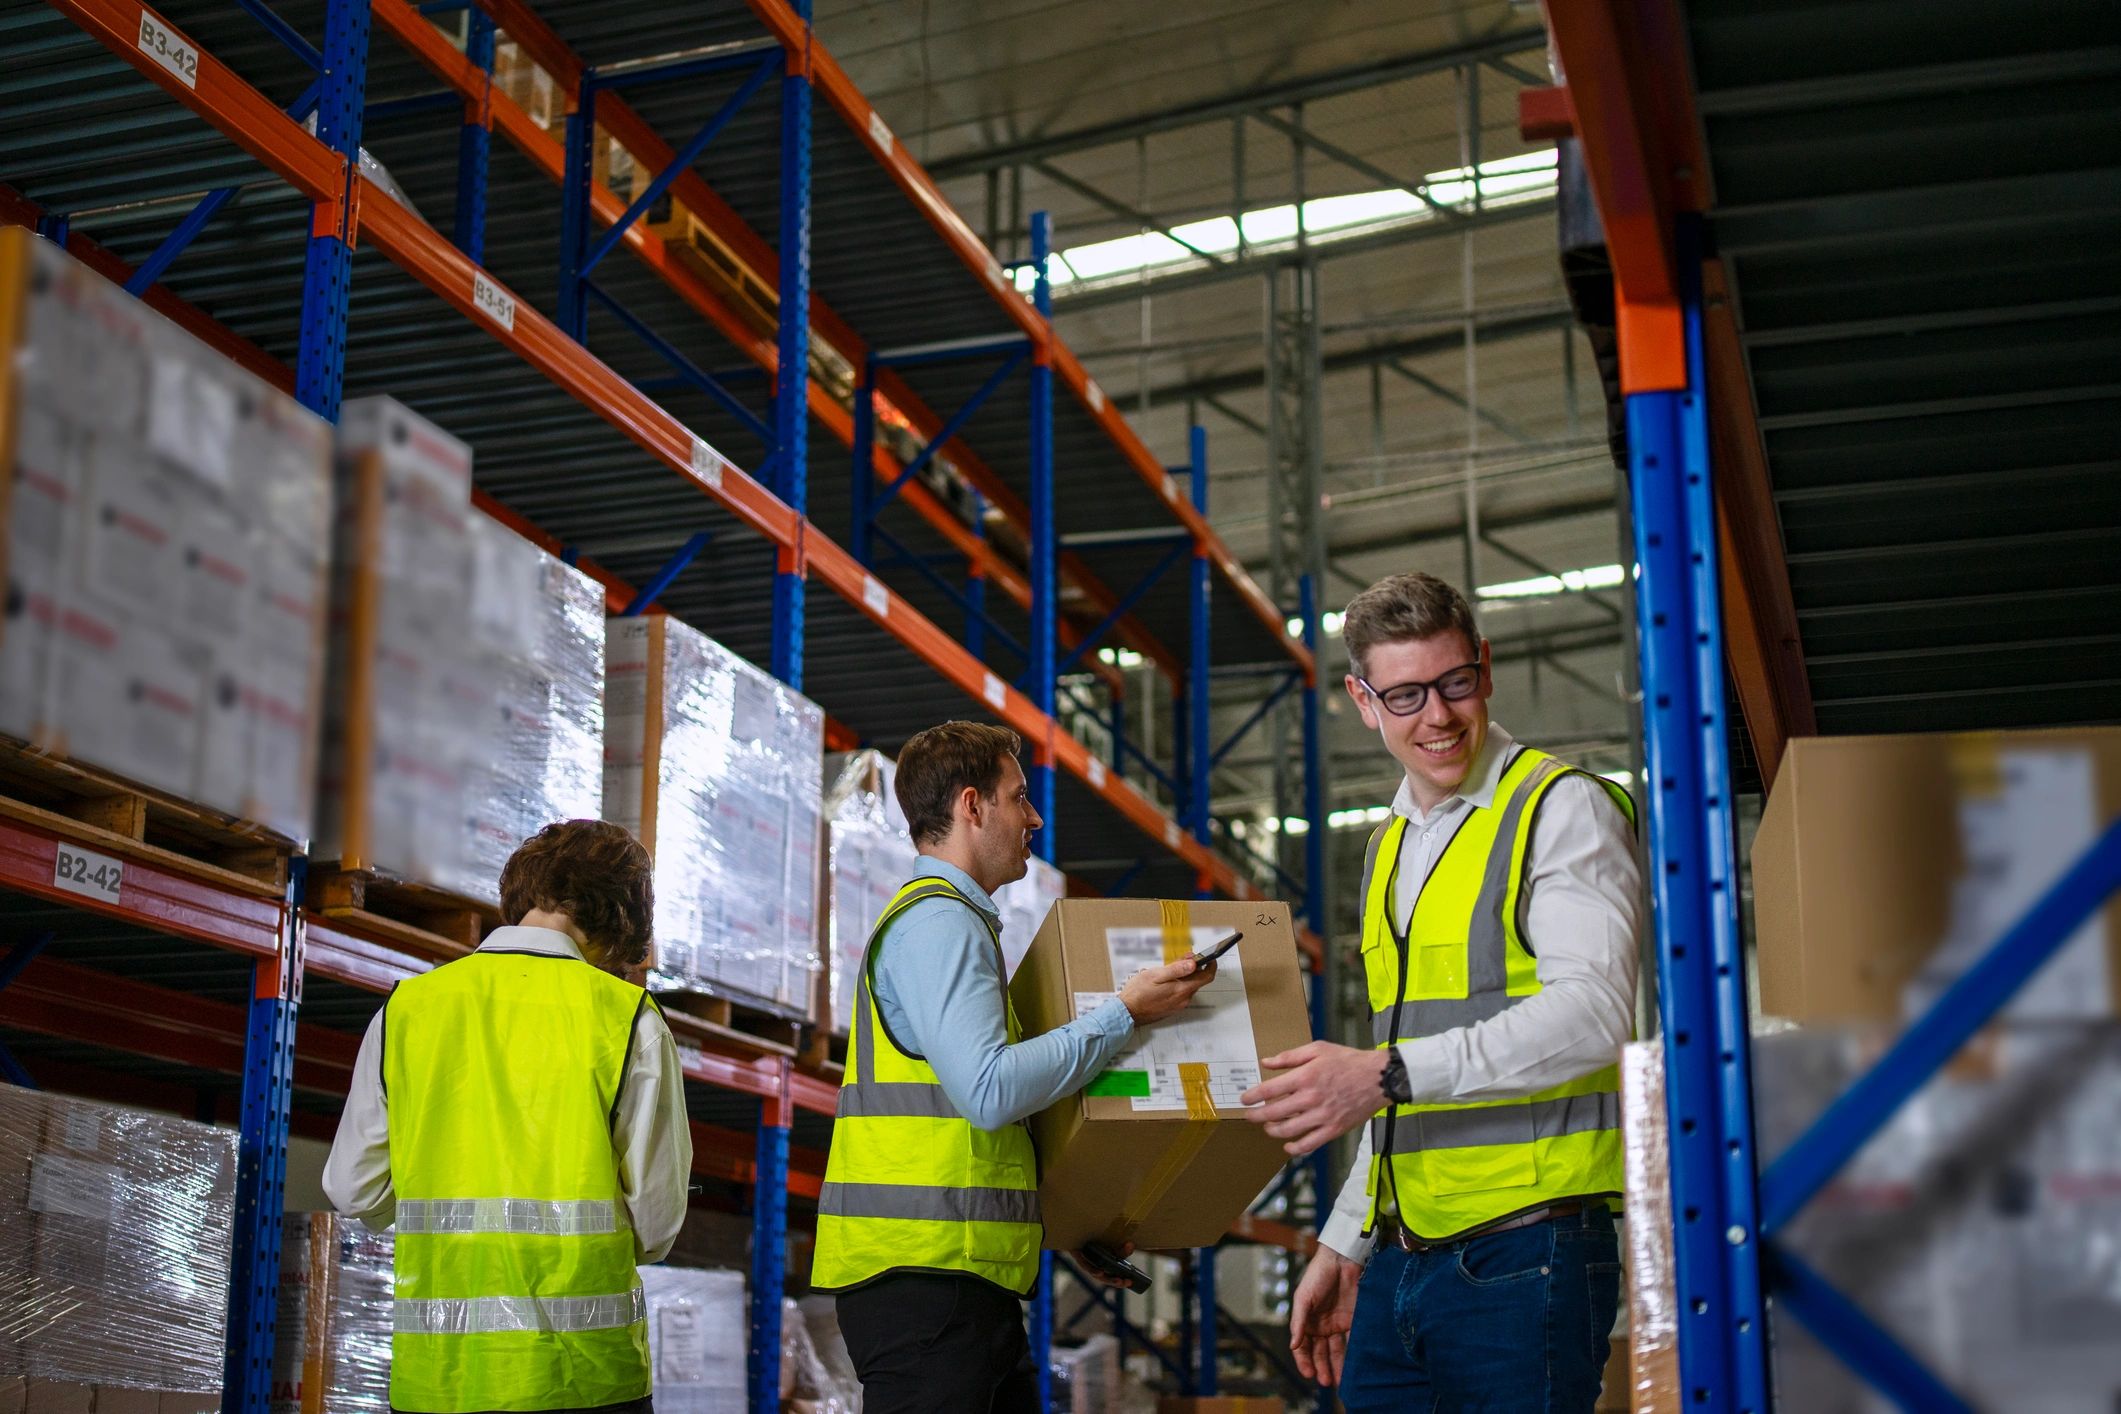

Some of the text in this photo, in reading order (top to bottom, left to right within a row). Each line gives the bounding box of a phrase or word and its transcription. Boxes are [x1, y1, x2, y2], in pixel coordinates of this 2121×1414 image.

[141, 19, 196, 79] B3-42
[475, 279, 513, 323] B3-51
[57, 852, 121, 893] B2-42
